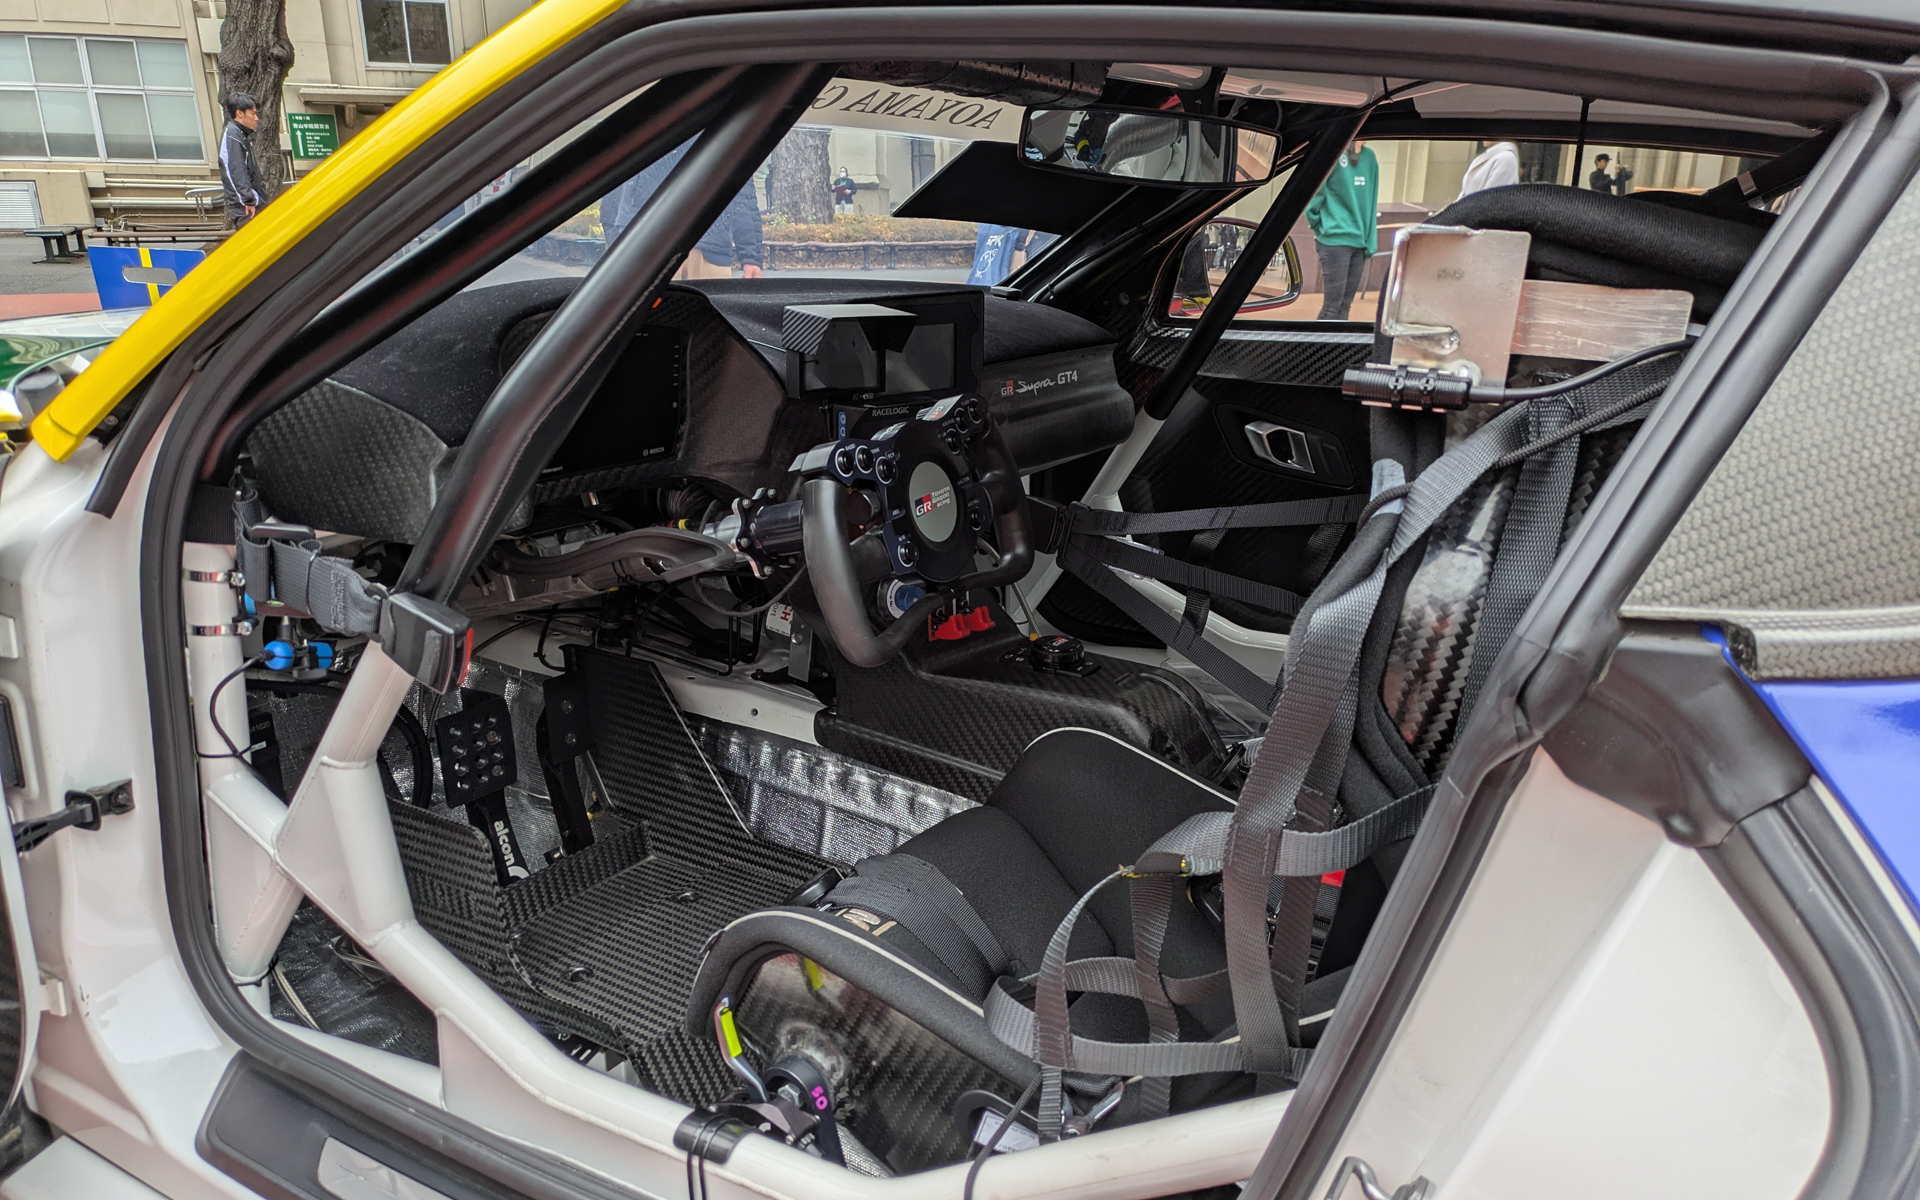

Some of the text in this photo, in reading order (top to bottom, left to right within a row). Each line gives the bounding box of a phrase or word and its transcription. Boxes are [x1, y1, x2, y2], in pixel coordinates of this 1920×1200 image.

[1001, 370, 1078, 397] GR Supra GT4
[872, 406, 910, 417] RACELOGIC
[649, 446, 665, 455] BOSCH
[931, 486, 950, 498] TOYOTA
[932, 492, 950, 504] GAZOO
[916, 501, 932, 516] GR
[494, 820, 515, 867] alcon
